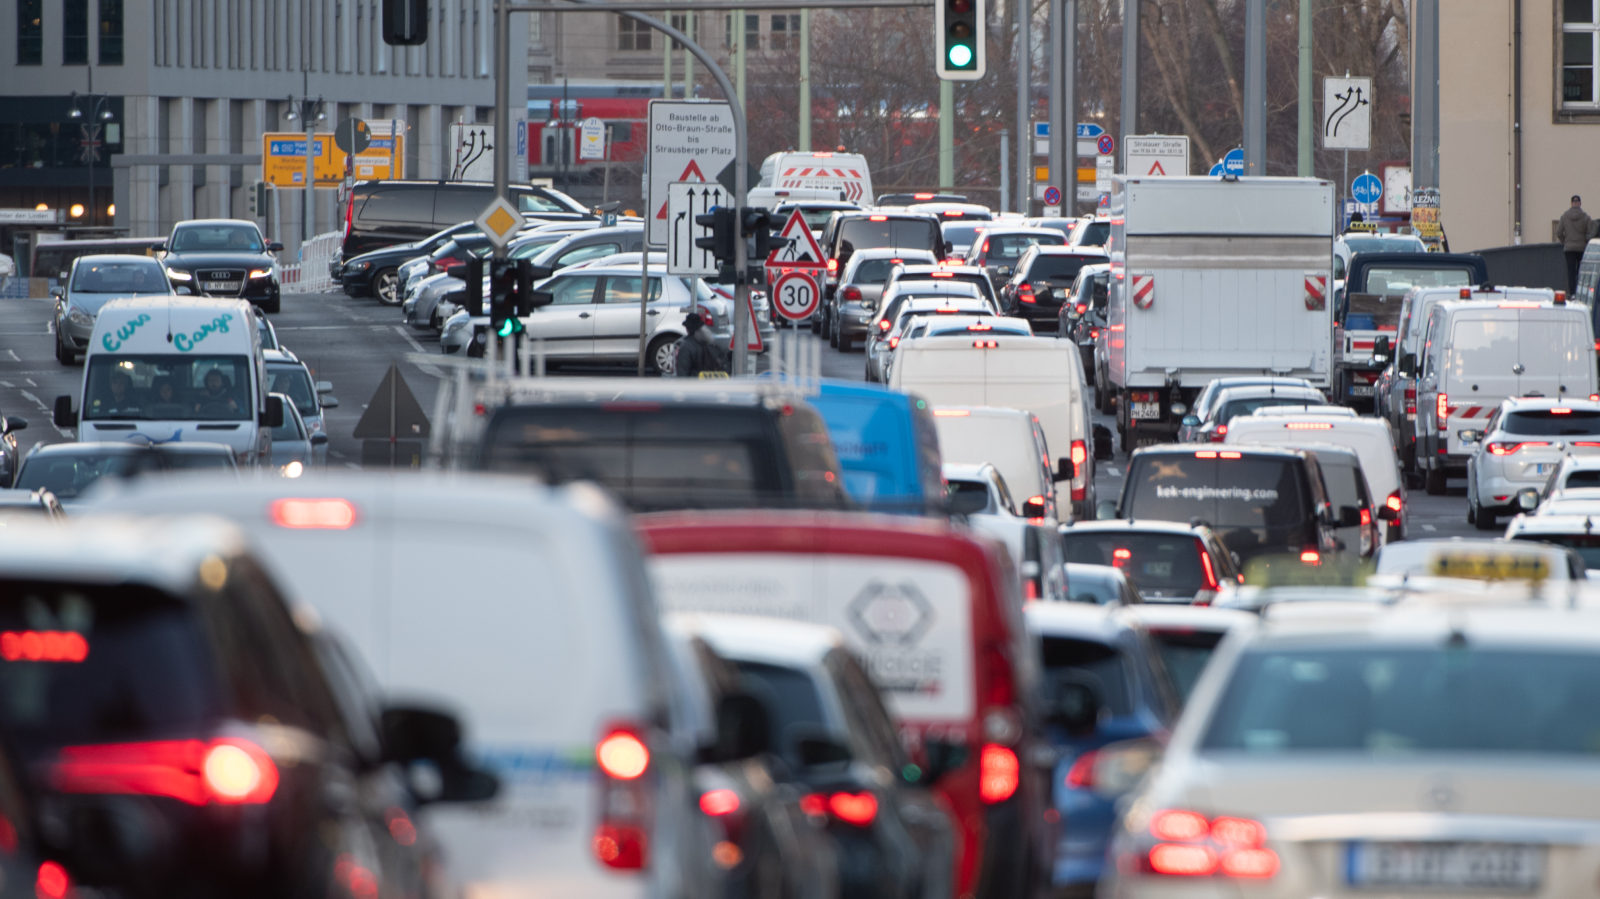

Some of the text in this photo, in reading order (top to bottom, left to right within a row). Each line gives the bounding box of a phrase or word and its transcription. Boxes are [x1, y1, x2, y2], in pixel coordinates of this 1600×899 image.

[669, 113, 719, 122] Baustelle ab
[655, 123, 733, 133] Otto-Braun-Straße
[687, 135, 700, 143] bis
[655, 144, 732, 156] Strausberger Platz
[607, 213, 616, 226] P
[784, 285, 810, 307] 30
[1156, 485, 1279, 502] kek-engineering.com
